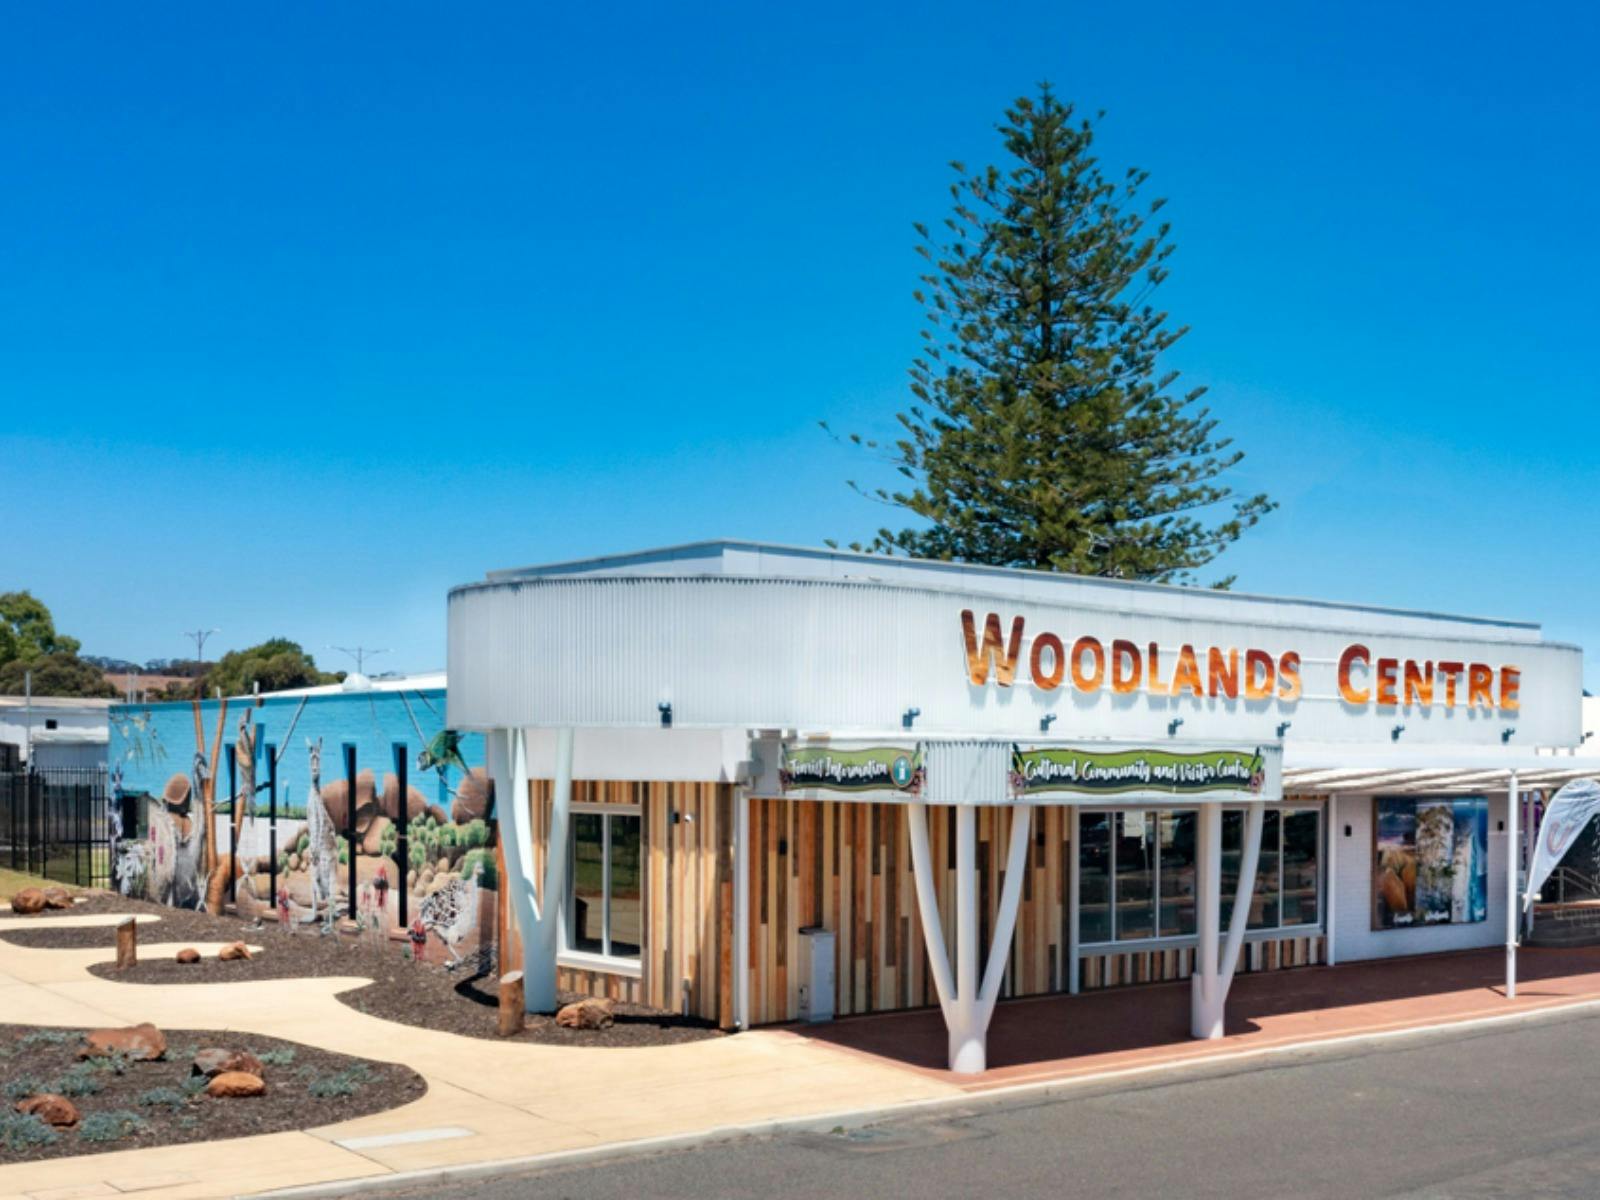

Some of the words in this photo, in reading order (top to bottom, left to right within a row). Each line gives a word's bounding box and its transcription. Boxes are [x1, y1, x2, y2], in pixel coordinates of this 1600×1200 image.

[961, 609, 1302, 702] WOODLANDS
[1338, 643, 1521, 710] CENTRE
[825, 756, 887, 782] Information
[1024, 758, 1079, 781] Cultural
[1082, 760, 1150, 782] Community
[1153, 762, 1178, 781] and
[1180, 762, 1214, 783] Visitor
[1217, 759, 1250, 780] Centre
